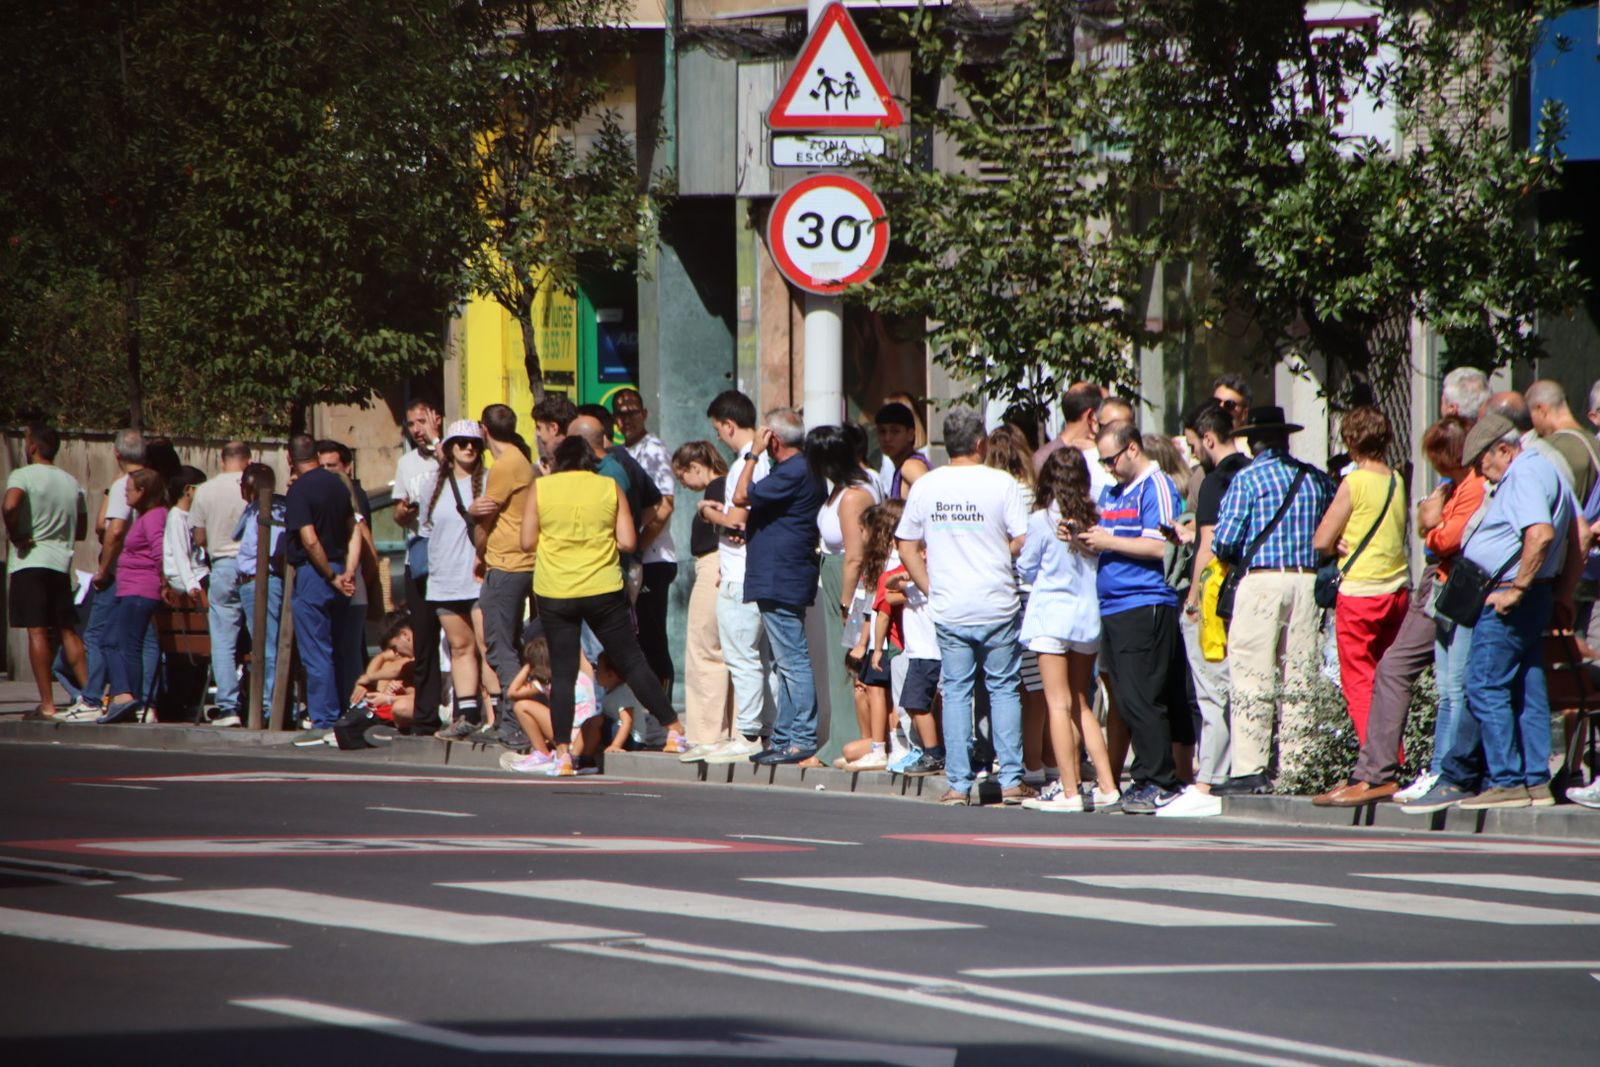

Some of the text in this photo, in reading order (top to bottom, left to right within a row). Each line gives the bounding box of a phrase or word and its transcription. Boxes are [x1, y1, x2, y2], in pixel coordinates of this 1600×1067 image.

[809, 140, 848, 150] ZONA
[796, 211, 861, 252] 30
[936, 501, 977, 511] Born in
[931, 512, 984, 522] the south
